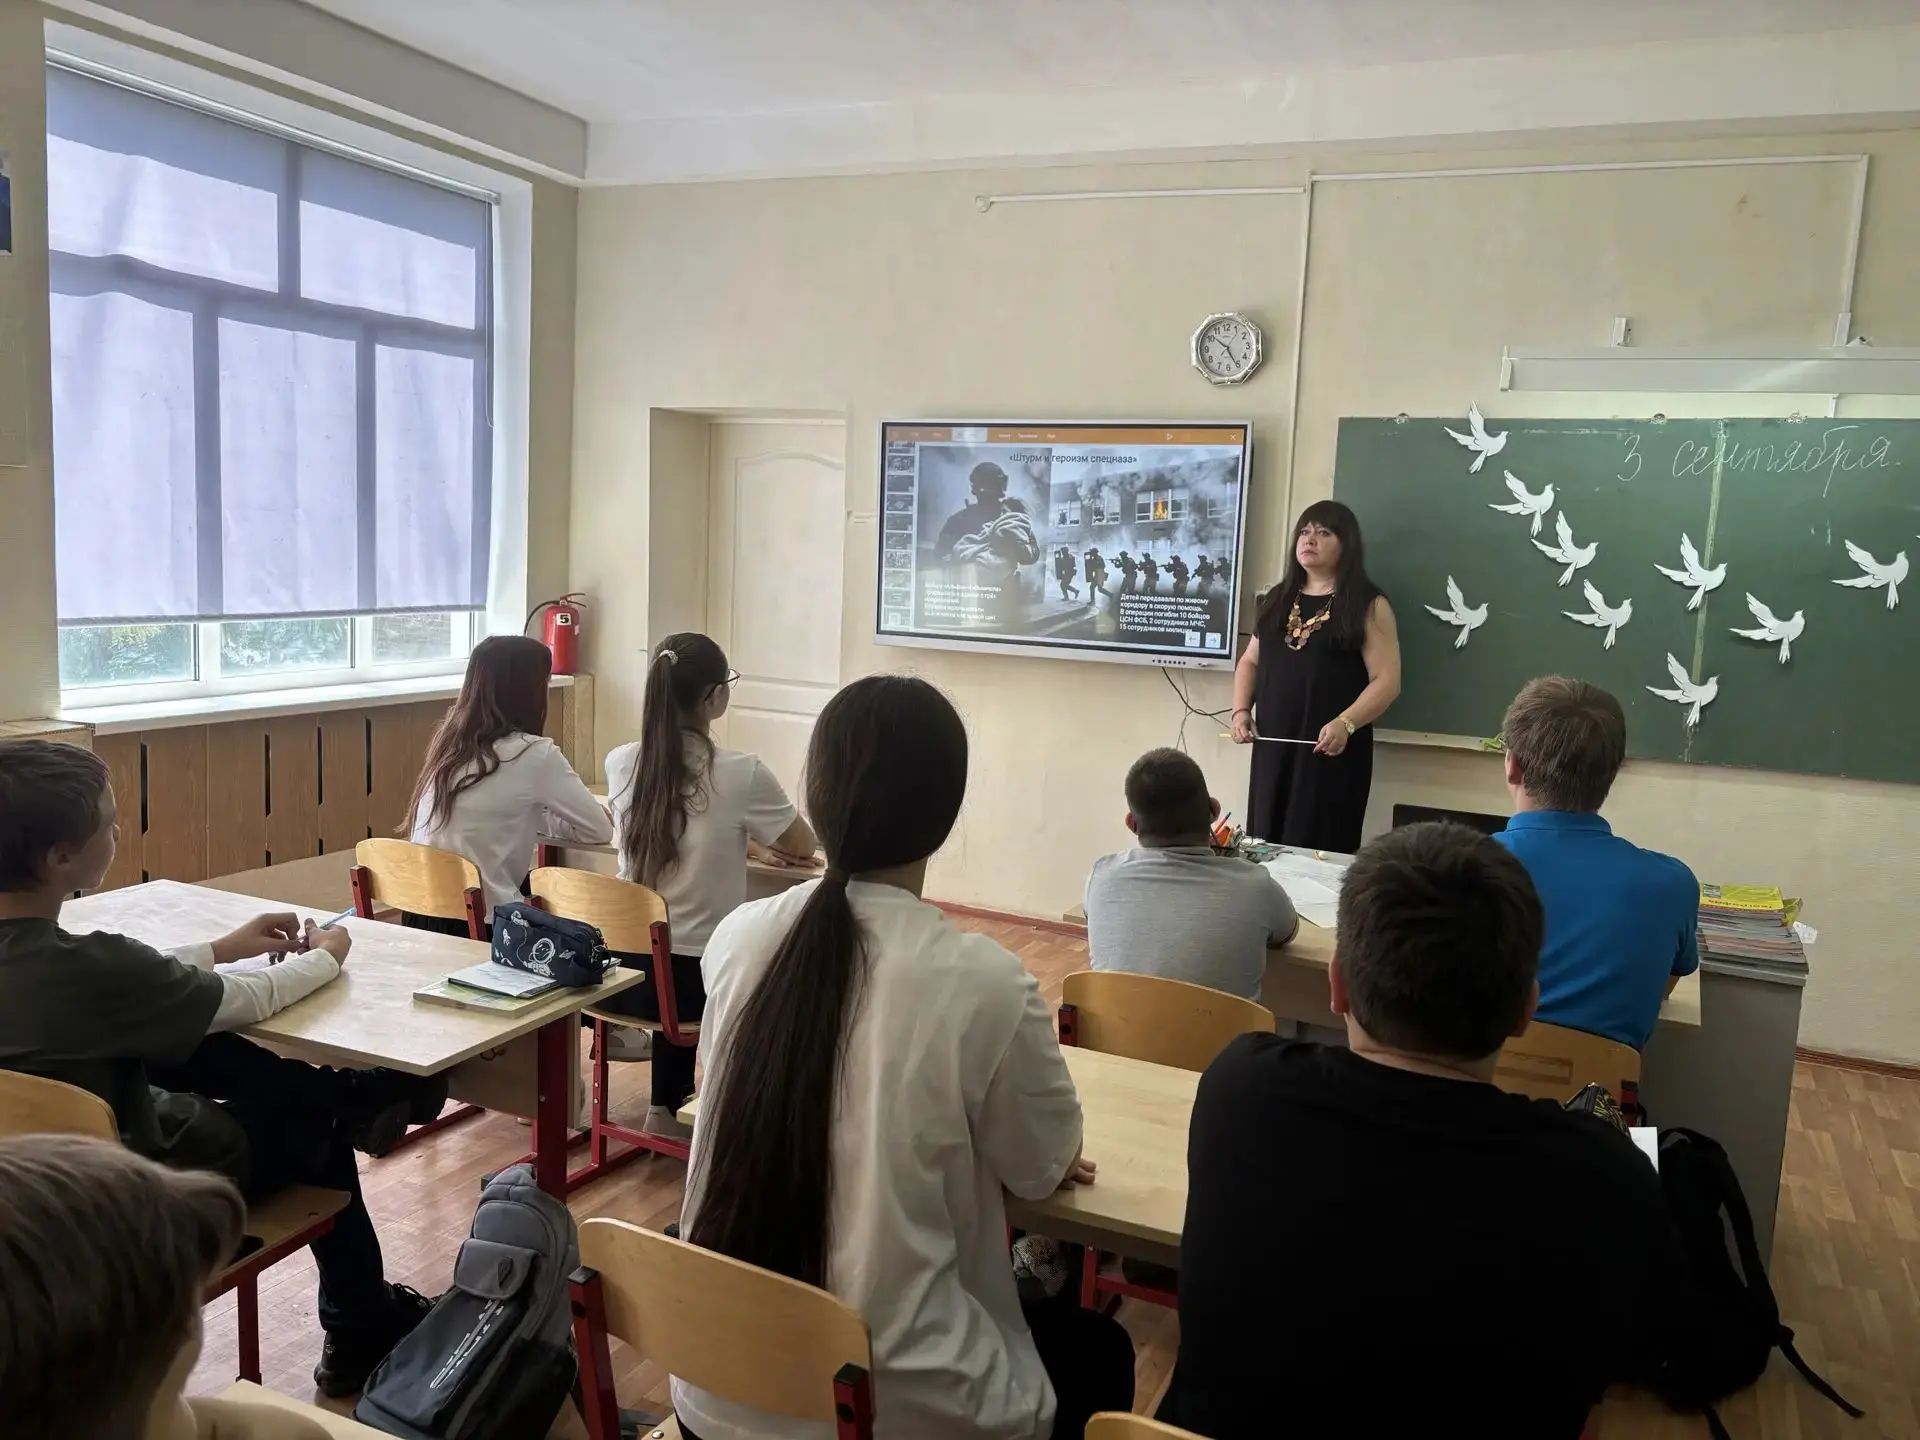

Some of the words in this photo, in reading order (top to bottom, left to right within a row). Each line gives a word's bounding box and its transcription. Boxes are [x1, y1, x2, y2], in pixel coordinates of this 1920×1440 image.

[1214, 327, 1220, 335] 11
[1242, 332, 1247, 340] 2
[1246, 342, 1250, 350] 3
[1217, 362, 1222, 370] 7
[1009, 452, 1042, 463] «Штурм
[1052, 455, 1089, 464] героизм
[1090, 456, 1137, 464] спецназа»
[1617, 435, 1642, 481] 3
[560, 615, 569, 623] 5
